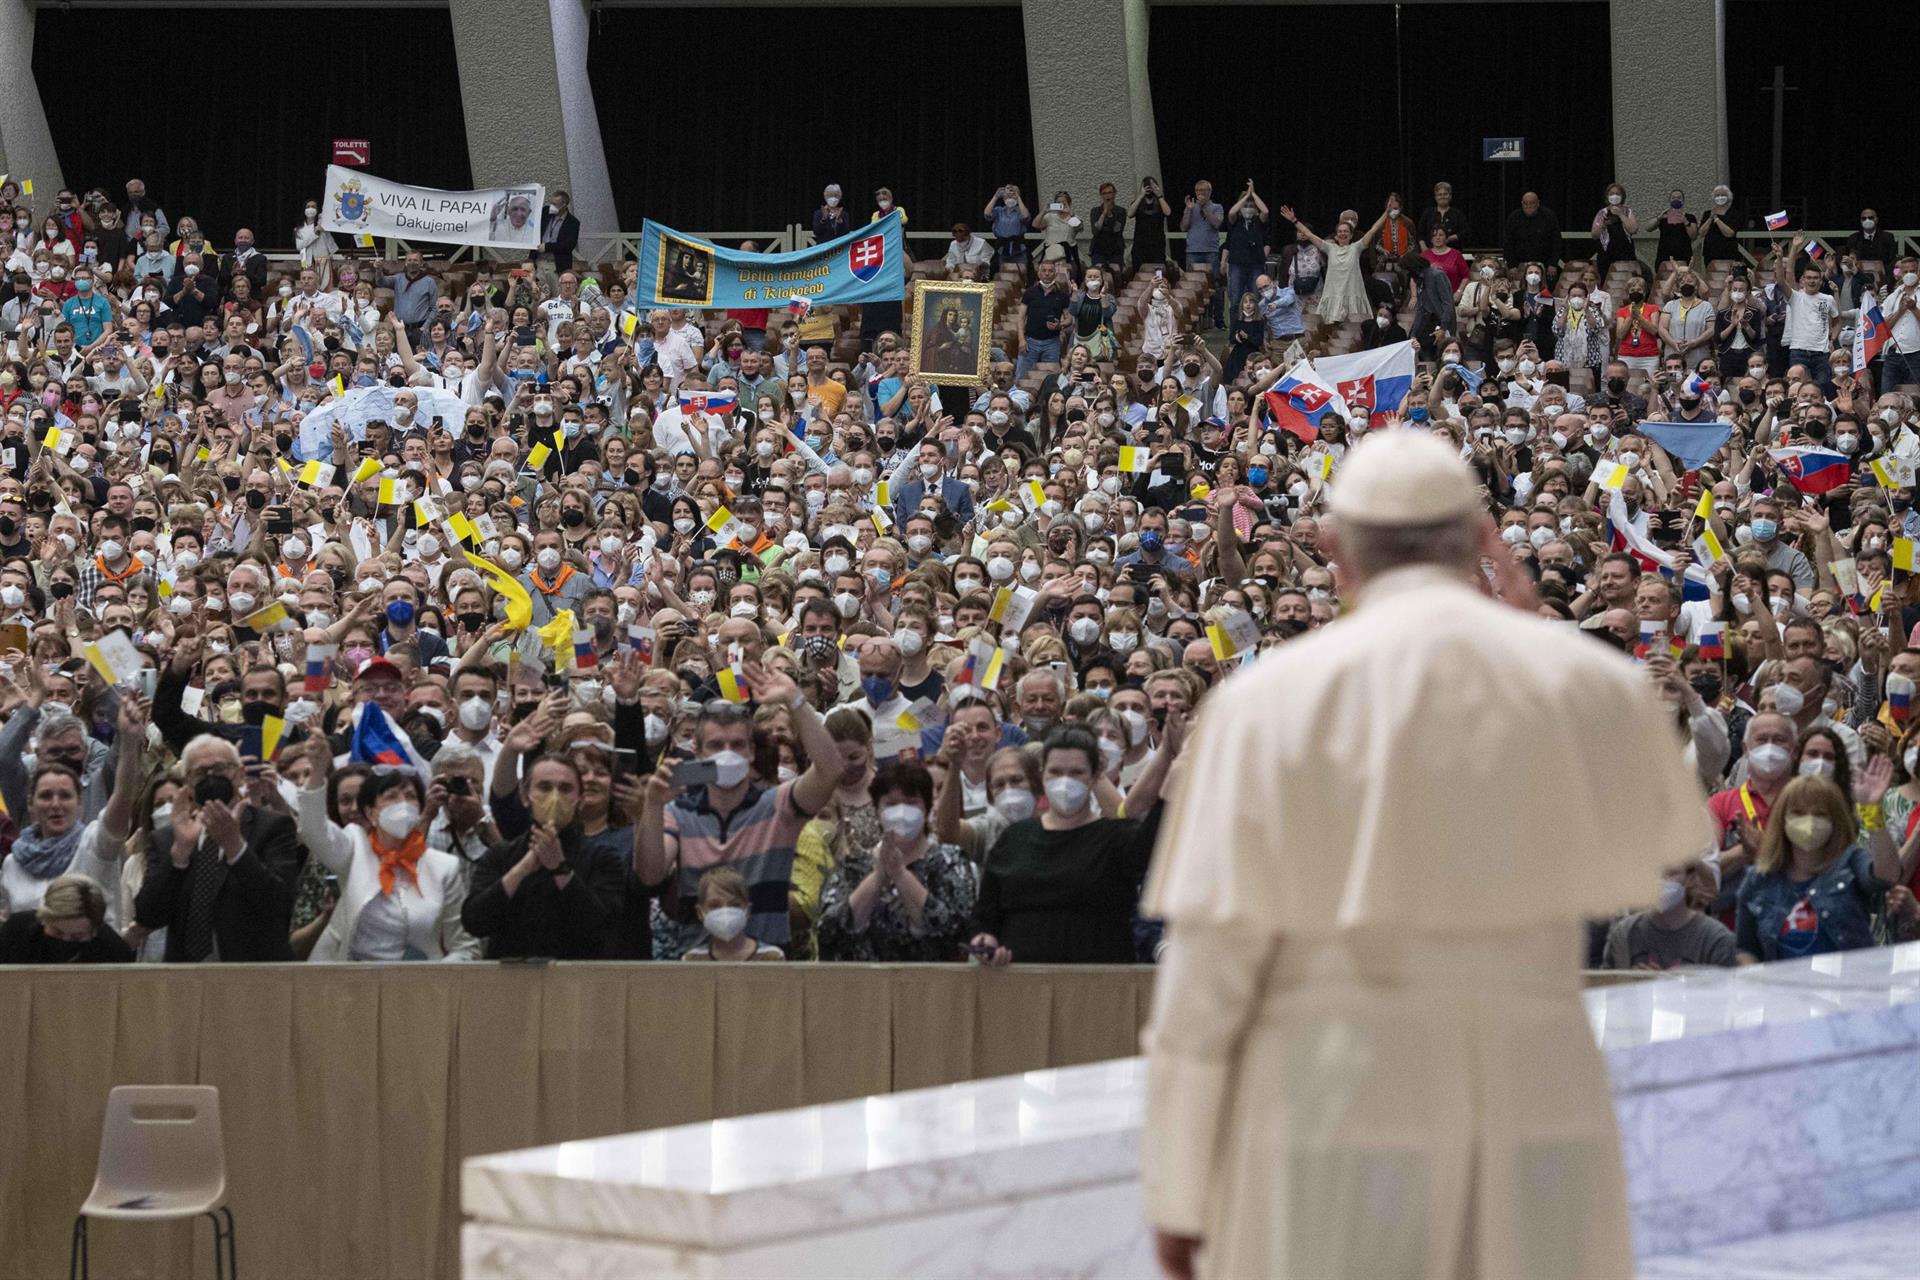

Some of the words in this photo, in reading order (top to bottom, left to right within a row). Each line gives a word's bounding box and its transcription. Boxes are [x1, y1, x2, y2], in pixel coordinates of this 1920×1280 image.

[380, 192, 417, 210] VIVA
[421, 198, 435, 212] IL
[440, 200, 487, 214] PAPA!
[396, 212, 468, 233] Ďakujeme!
[744, 287, 758, 300] di
